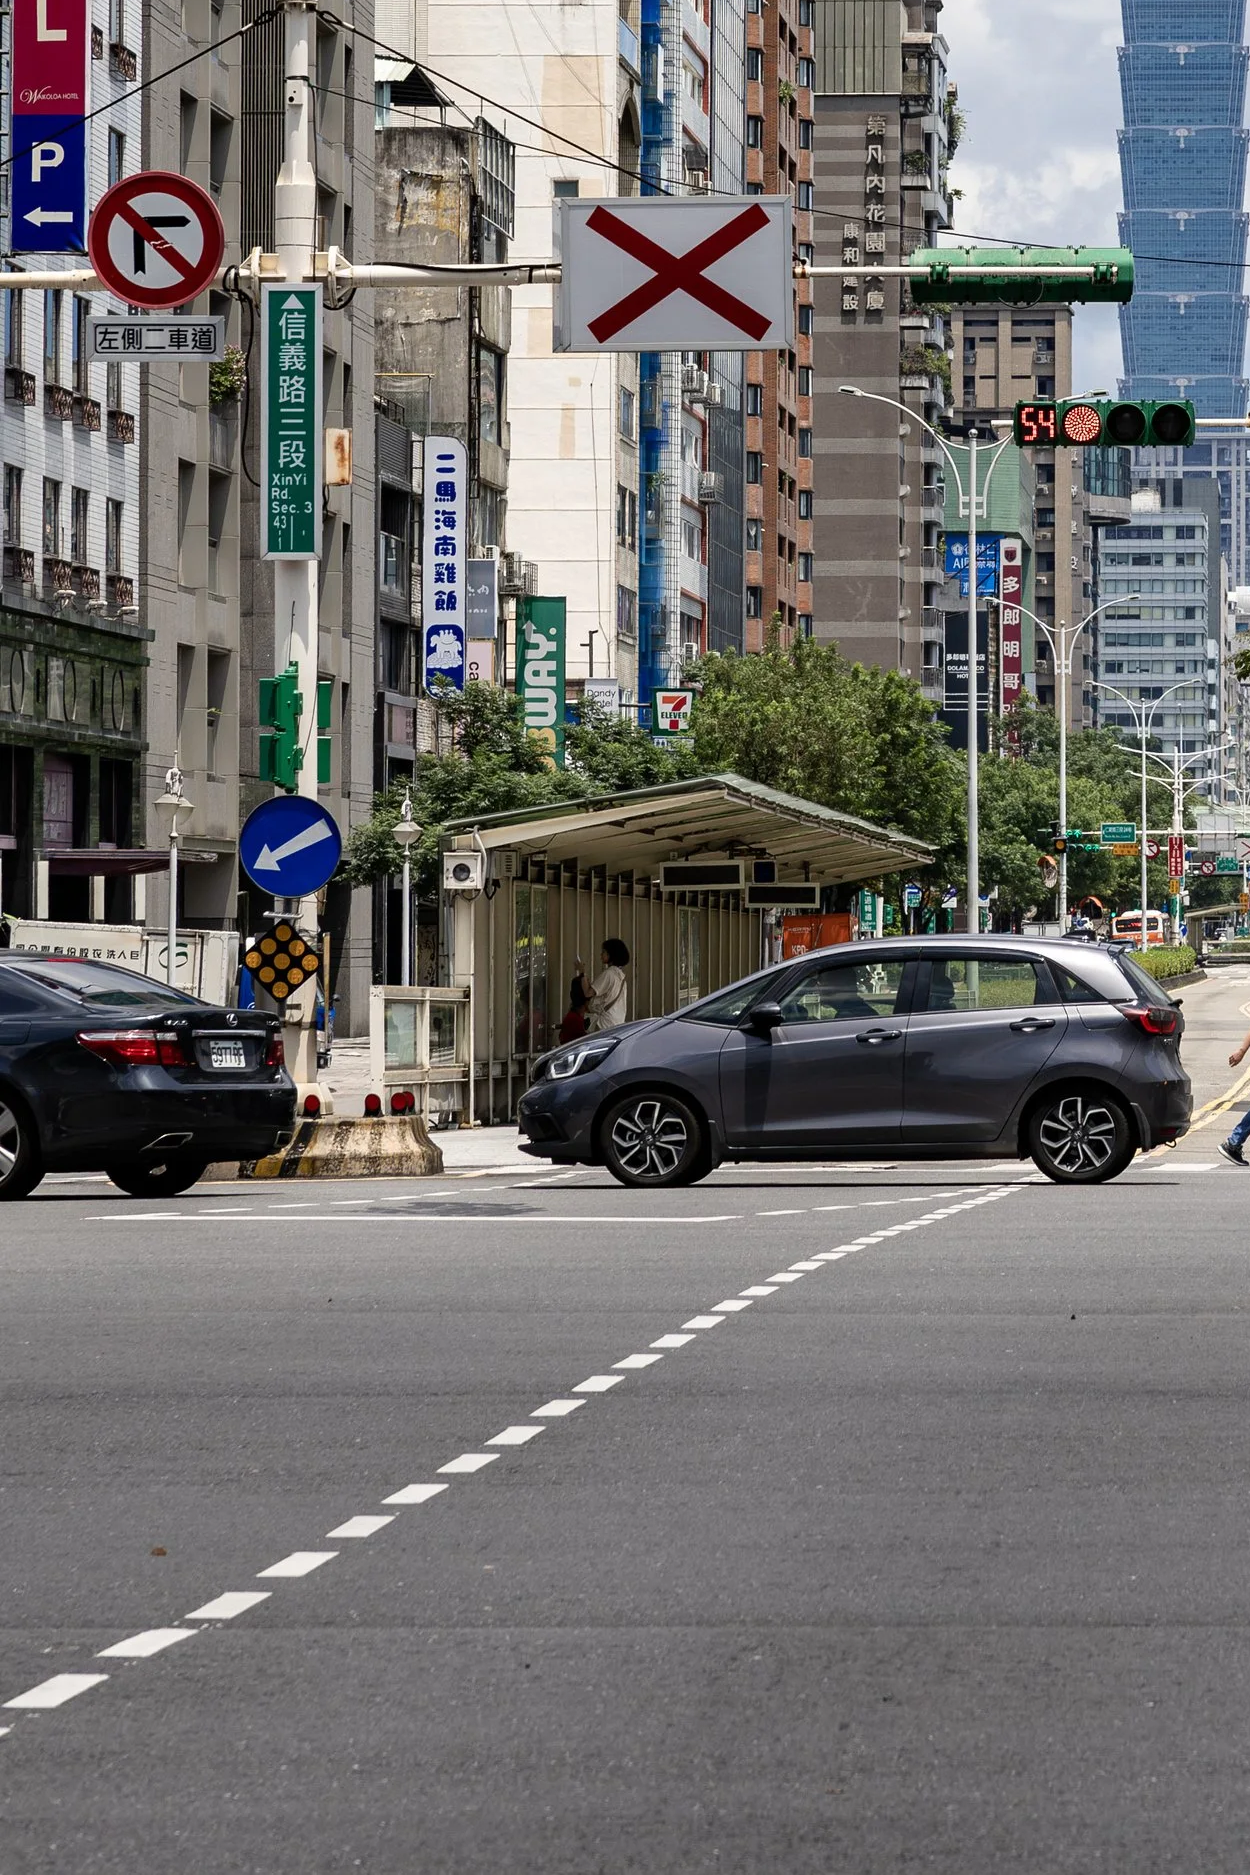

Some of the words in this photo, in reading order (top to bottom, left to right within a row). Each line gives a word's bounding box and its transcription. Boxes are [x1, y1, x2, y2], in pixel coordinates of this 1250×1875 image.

[31, 142, 65, 182] P
[98, 327, 214, 352] 左側二車道
[278, 312, 307, 469] 信義路三段
[1021, 407, 1054, 441] 54
[272, 473, 307, 486] XinYi
[271, 487, 292, 500] Rd.
[271, 501, 300, 514] Sec.
[304, 501, 313, 514] 3
[273, 515, 287, 529] 43
[524, 620, 557, 772] BWAY
[587, 688, 617, 700] Dandy
[593, 698, 614, 709] otel
